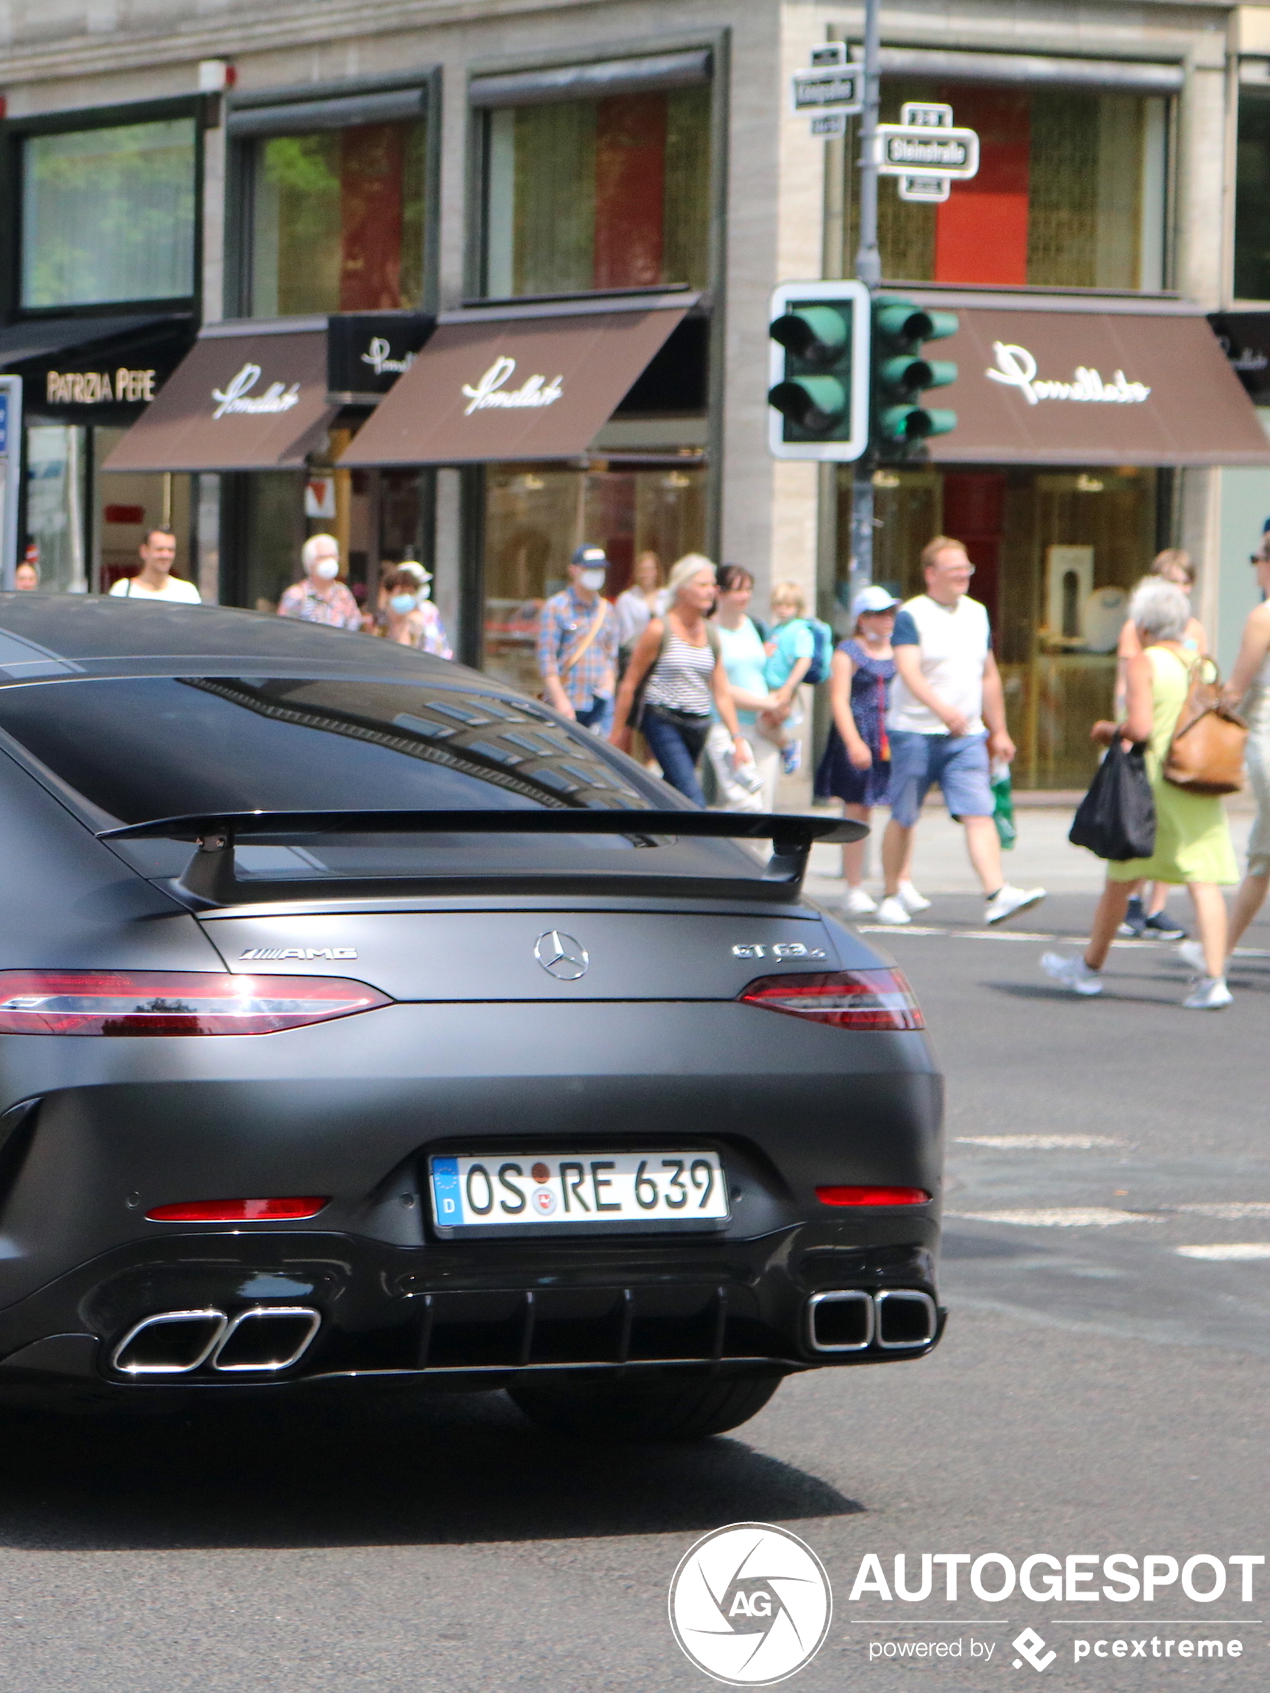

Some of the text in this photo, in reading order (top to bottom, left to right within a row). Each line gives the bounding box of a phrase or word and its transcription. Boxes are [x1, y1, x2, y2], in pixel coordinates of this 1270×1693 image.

[890, 138, 967, 165] Steinstraße
[47, 368, 156, 403] PATRIZIA PEPE
[462, 356, 564, 416] Pomellato
[985, 340, 1151, 405] Pomellato
[212, 362, 301, 420] Pomellato
[272, 947, 358, 961] AMG
[732, 944, 767, 960] GT
[772, 943, 808, 958] 63
[465, 1158, 714, 1216] OS RE 639
[443, 1198, 456, 1214] D
